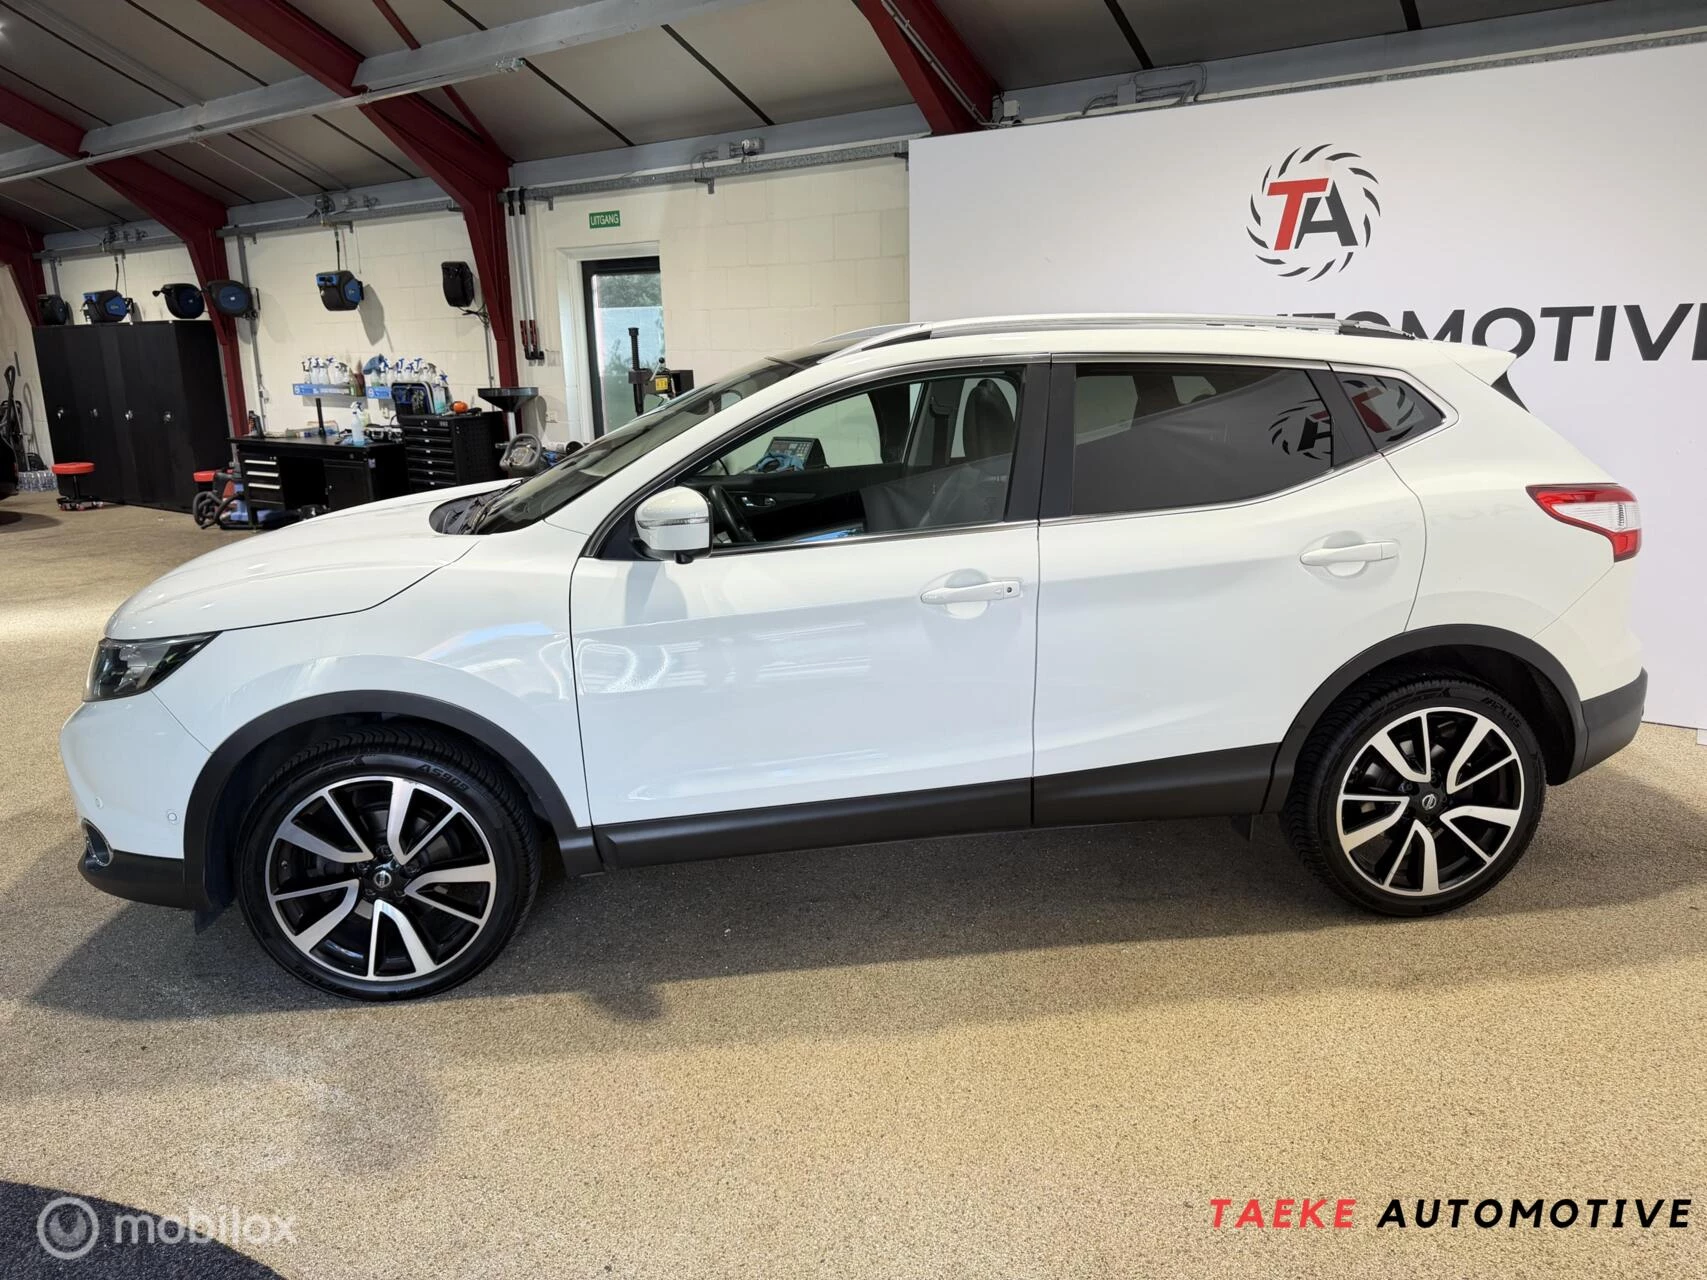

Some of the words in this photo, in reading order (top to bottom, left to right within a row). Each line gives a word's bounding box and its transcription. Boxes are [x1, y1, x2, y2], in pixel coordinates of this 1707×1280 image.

[590, 213, 619, 226] UITGANG
[1266, 178, 1358, 250] TA
[1276, 303, 1707, 362] MOTIV
